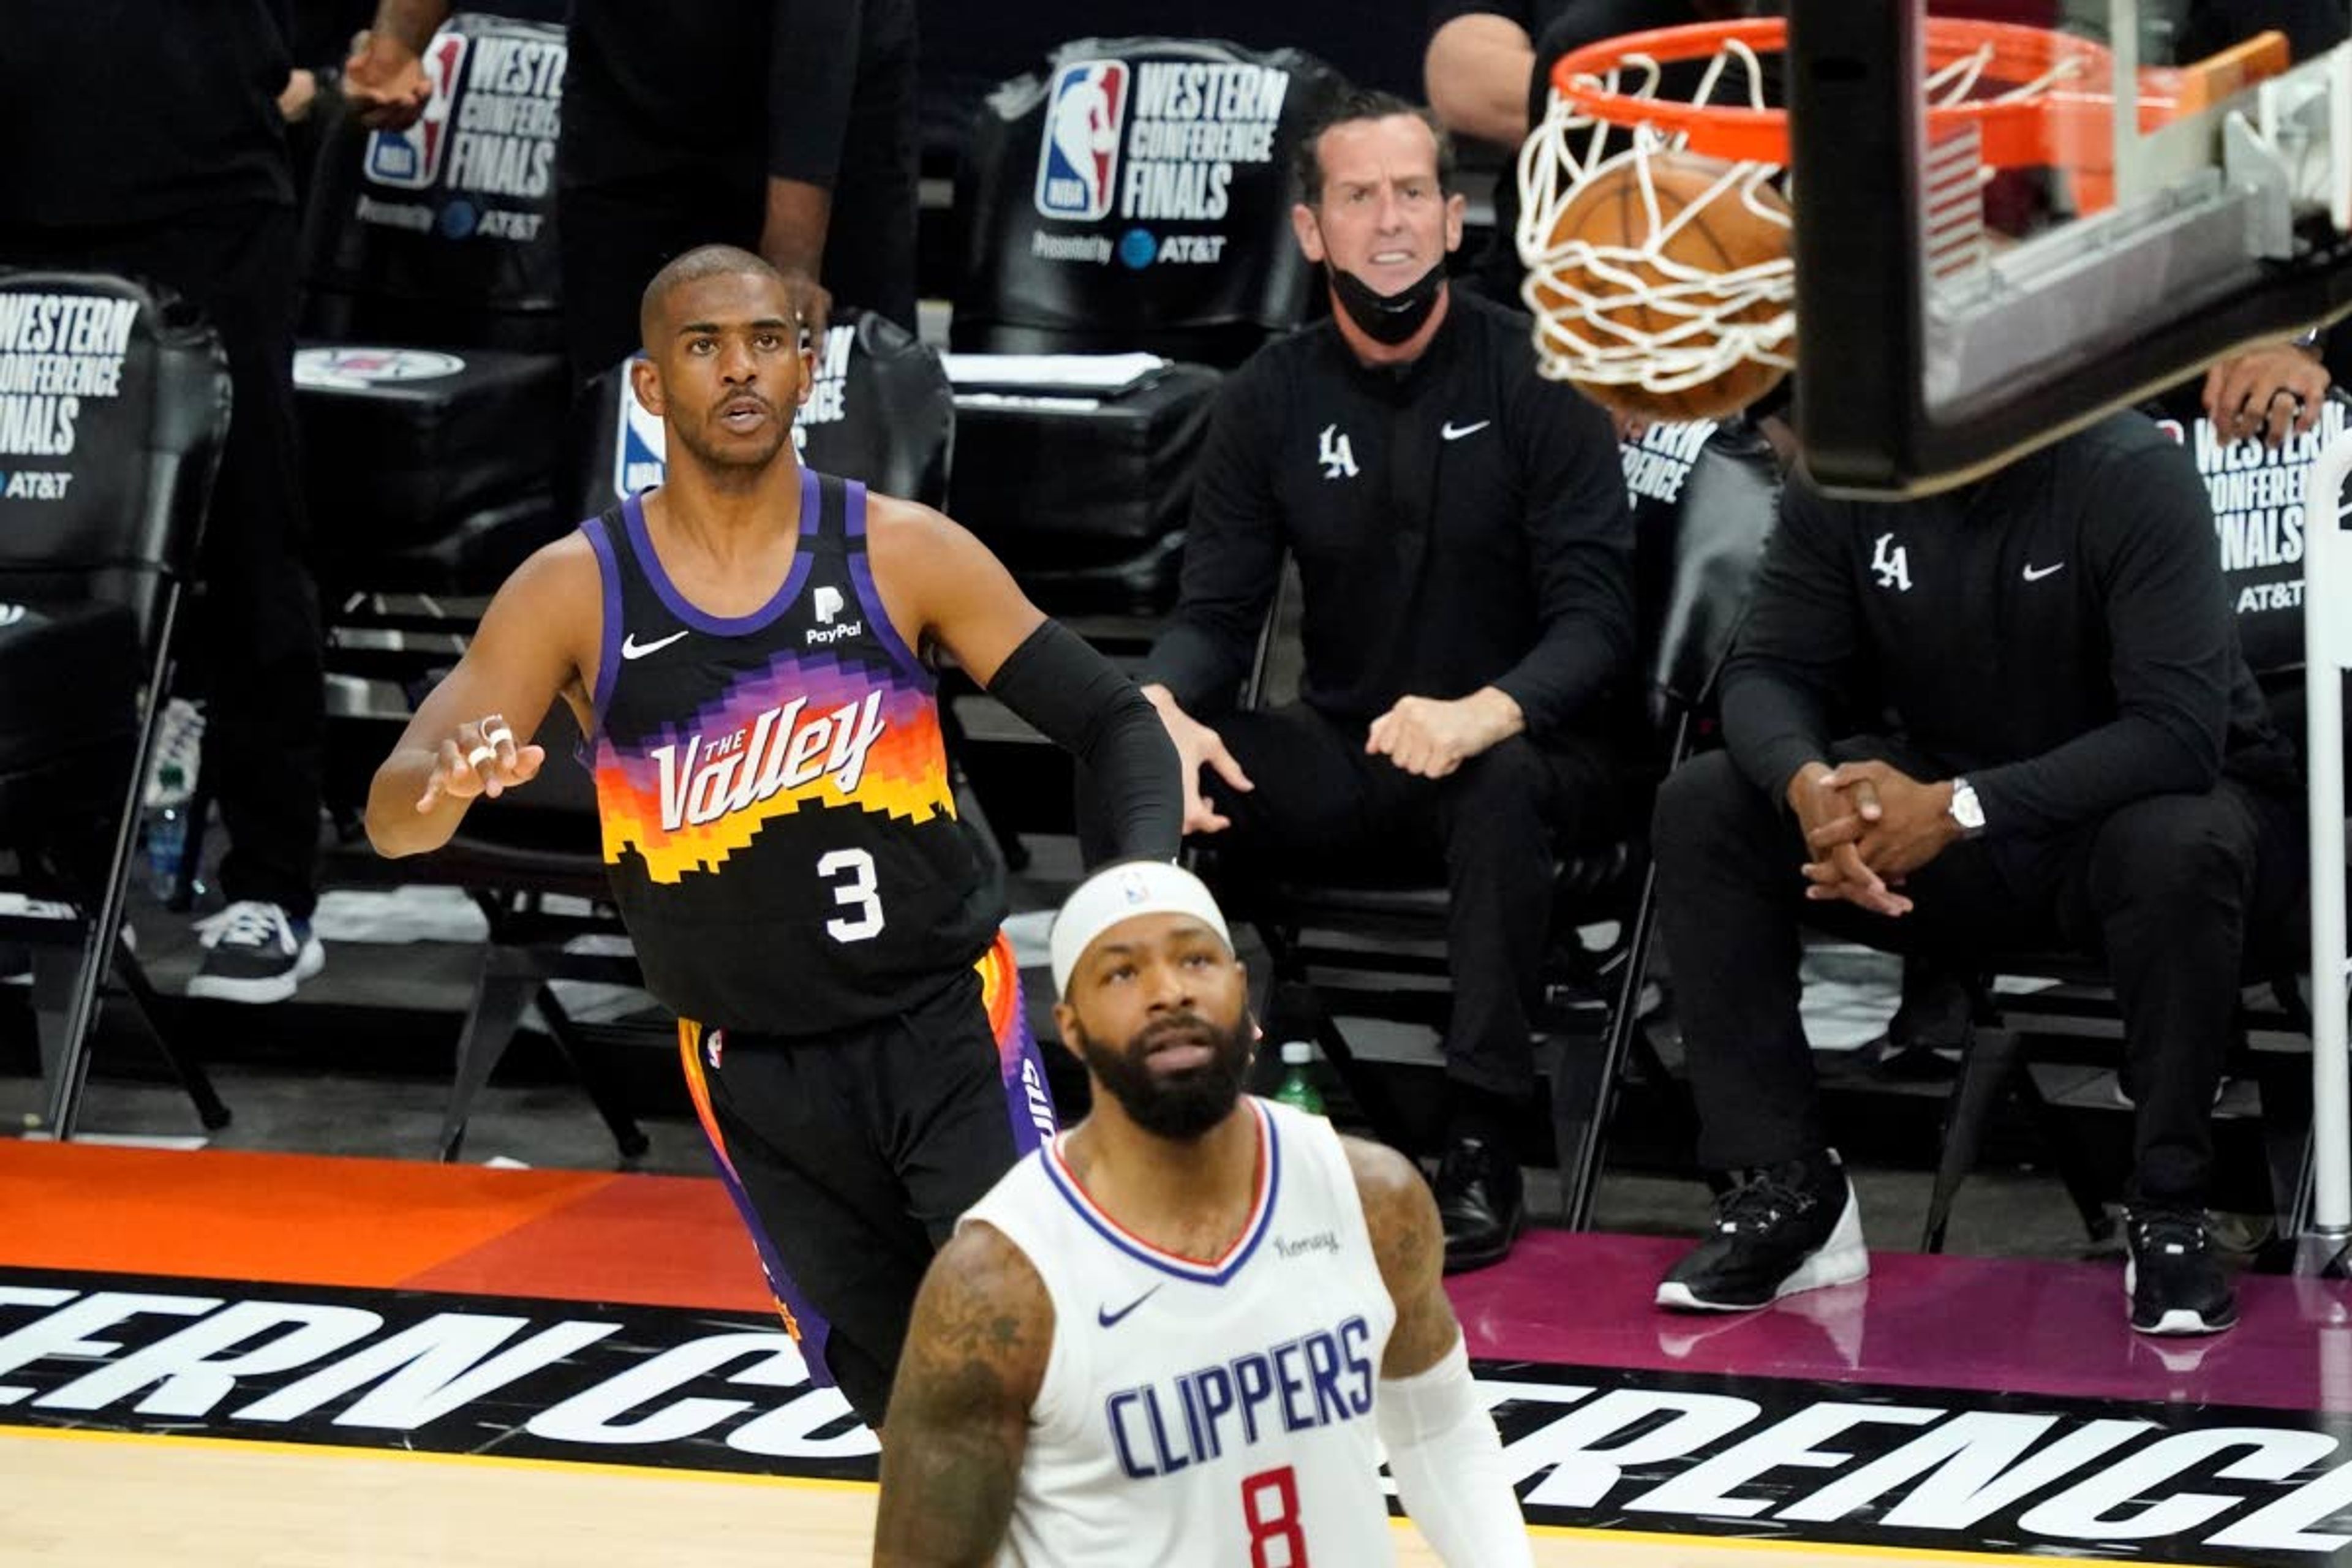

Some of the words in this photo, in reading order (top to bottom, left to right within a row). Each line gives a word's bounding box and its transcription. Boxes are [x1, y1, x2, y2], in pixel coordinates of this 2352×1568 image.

[1135, 62, 1290, 121] WESTERN
[447, 130, 556, 198] FINALS
[1128, 120, 1278, 162] CONFERENCE
[1121, 160, 1233, 219] FINALS
[1157, 235, 1227, 263] AT&T
[0, 353, 126, 398] ONFERENCE
[1318, 423, 1360, 479] LA
[5, 470, 74, 499] AT&T
[1871, 532, 1912, 591] LA
[2236, 579, 2306, 614] AT&T
[806, 620, 861, 644] PayPal
[650, 690, 886, 831] Valley
[705, 729, 747, 762] THE
[816, 848, 885, 943] 3
[1105, 1315, 1373, 1480] CLIPPERS
[1241, 1464, 1308, 1568] 8
